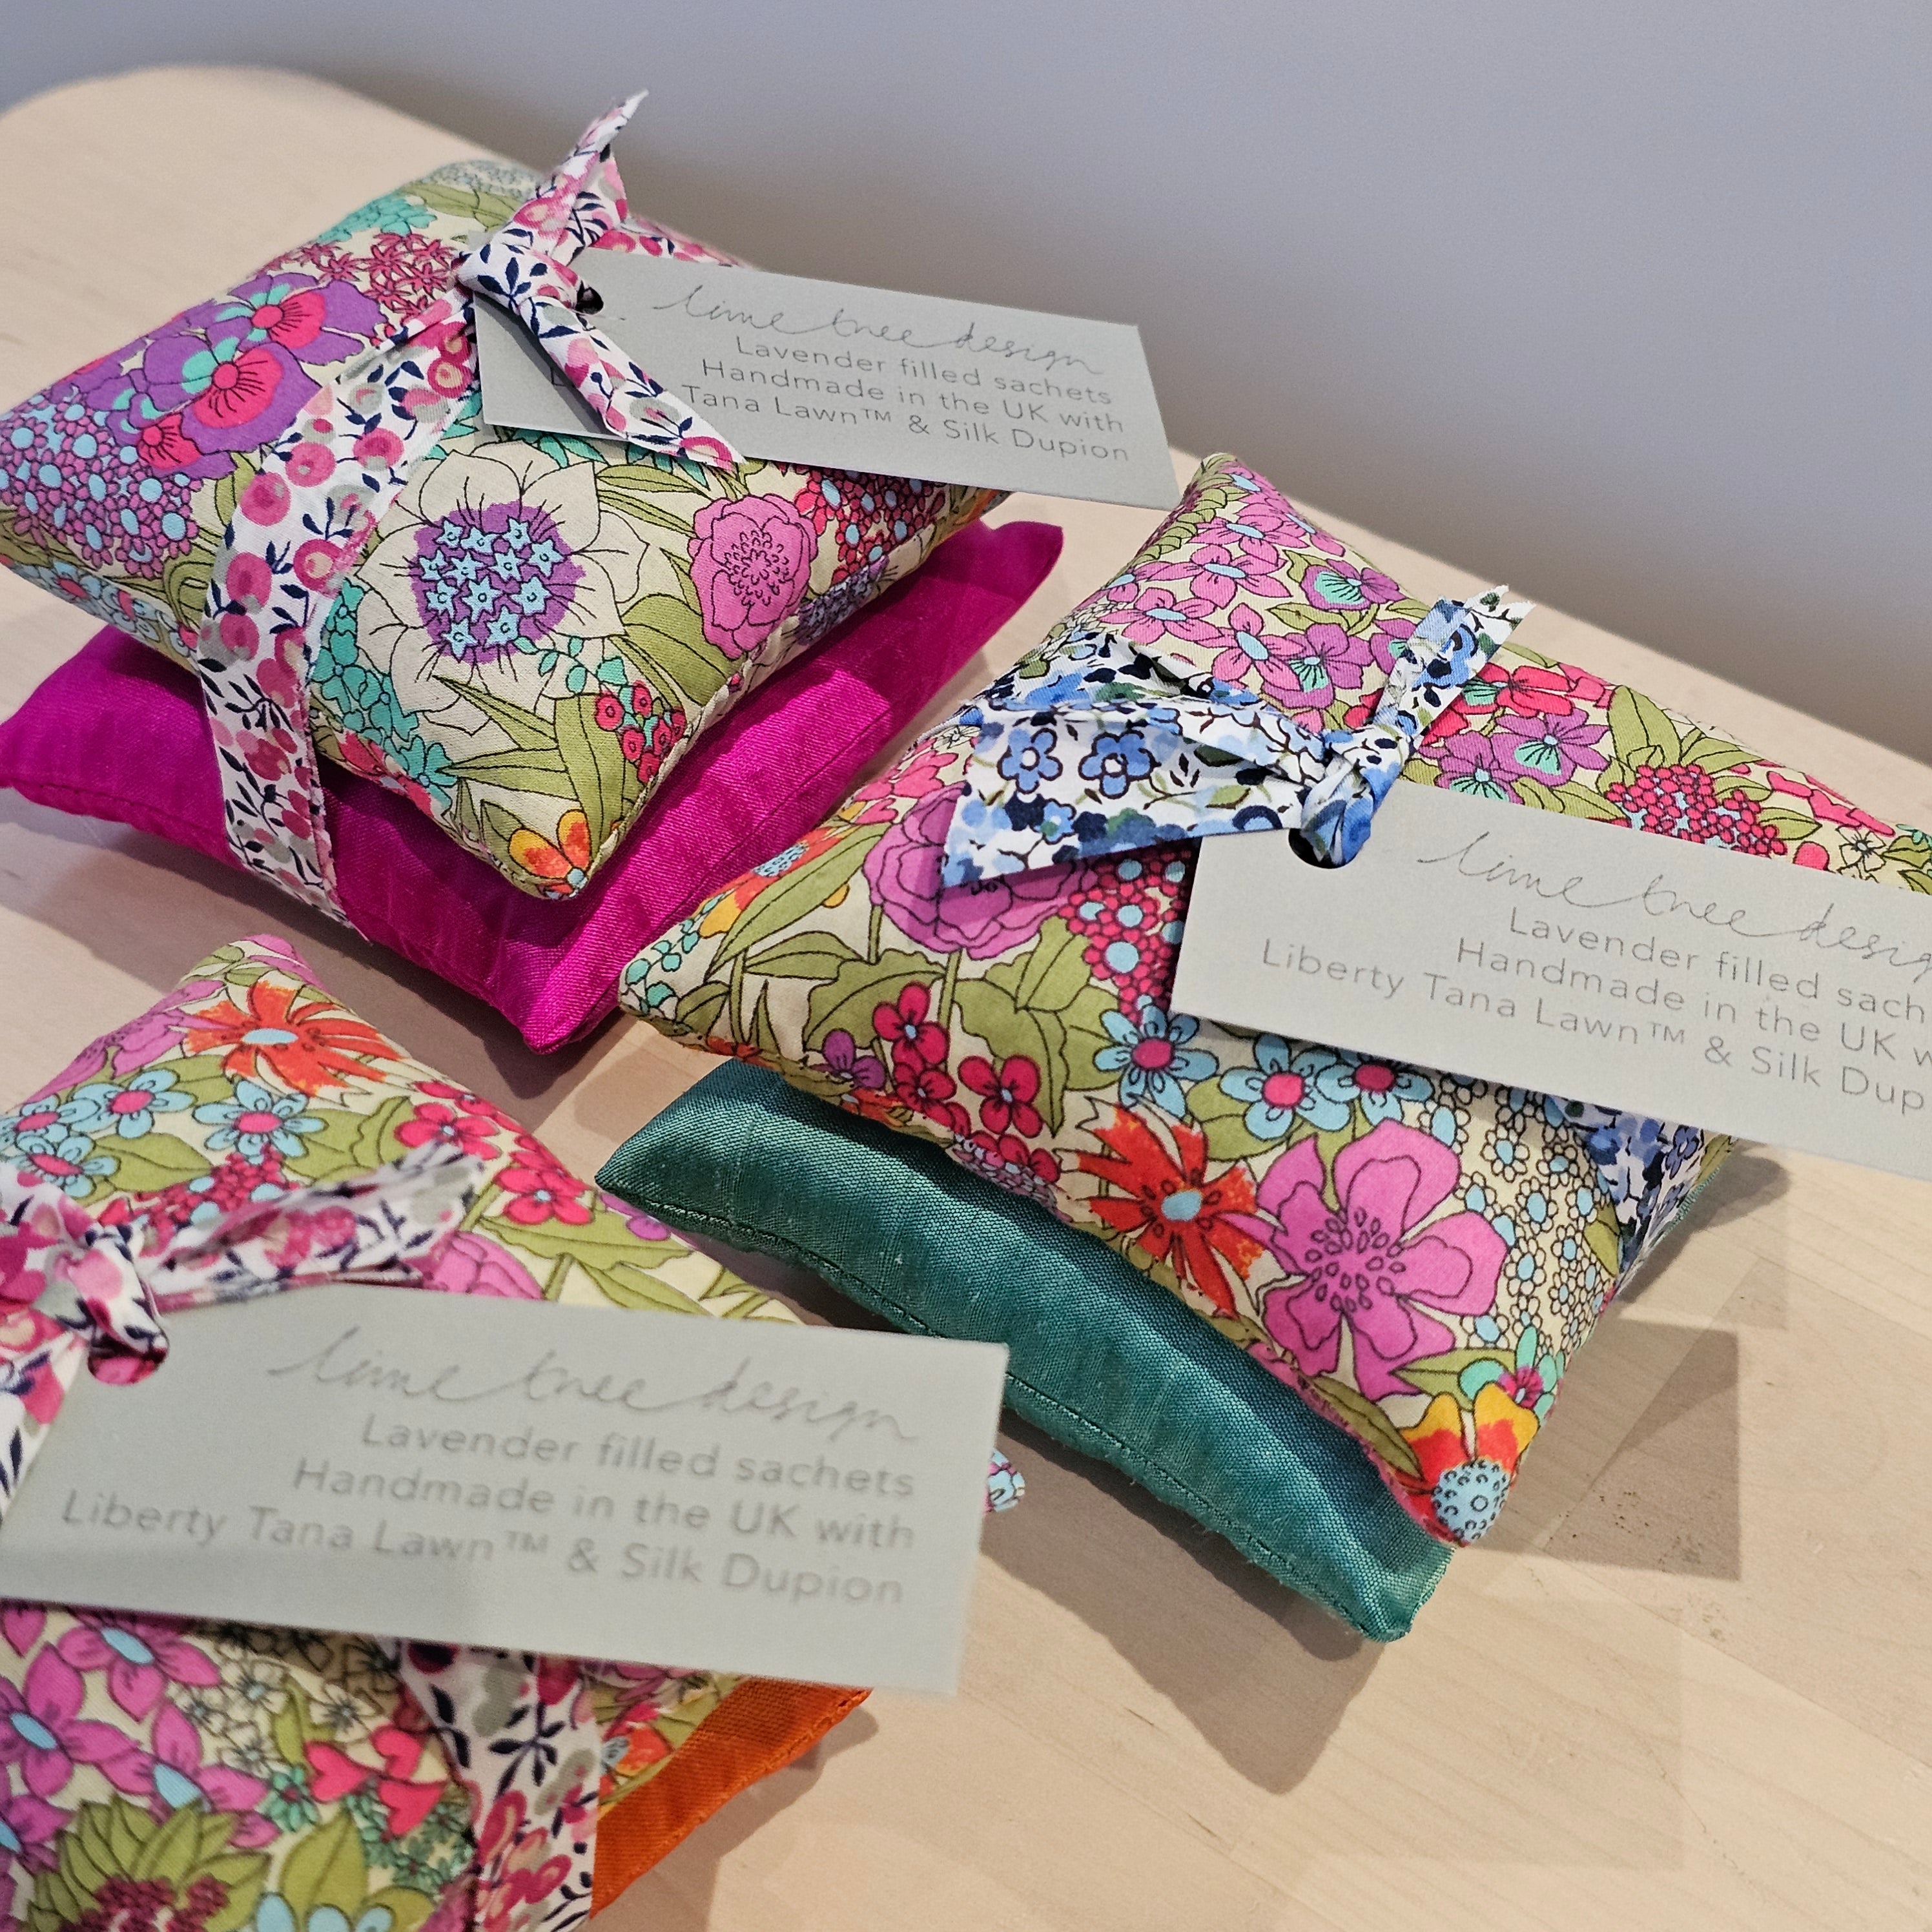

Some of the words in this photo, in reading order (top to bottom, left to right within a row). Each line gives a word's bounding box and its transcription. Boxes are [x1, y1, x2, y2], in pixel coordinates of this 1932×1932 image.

[653, 284, 802, 334] lime
[823, 308, 925, 348] tree
[952, 322, 1104, 375] design
[736, 336, 886, 372] Lavender
[900, 358, 981, 387] filled
[994, 378, 1112, 405] sachets
[682, 384, 760, 413] Tana
[909, 414, 930, 435] &
[943, 418, 1000, 444] Silk
[1011, 427, 1129, 461] Dupion
[703, 358, 884, 400] Handmade
[898, 385, 925, 407] in
[940, 391, 989, 415] the
[1003, 399, 1048, 423] UK
[1060, 412, 1124, 433] with
[1417, 831, 1595, 908] lime
[1630, 874, 1760, 938] tree
[1457, 936, 1685, 1011] Handmade
[1703, 992, 1737, 1023] in
[1755, 1005, 1821, 1042] the
[1841, 1022, 1896, 1061] UK
[1510, 907, 1700, 971] Lavender
[1715, 951, 1820, 1000] filled
[1837, 987, 1925, 1023] sach
[1263, 938, 1404, 999] Liberty
[1423, 971, 1516, 1018] Tana
[1705, 1035, 1732, 1067] &
[1751, 1045, 1822, 1087] Silk
[1842, 1065, 1924, 1116] Dup
[361, 1412, 580, 1463] Lavender
[596, 1430, 721, 1479] filled
[735, 1452, 916, 1499] sachets
[61, 1488, 227, 1547] Liberty
[248, 1503, 355, 1548] Tana
[566, 1537, 598, 1573] &
[620, 1541, 703, 1584] Silk
[721, 1550, 903, 1604] Dupion
[293, 1457, 555, 1513] Handmade
[572, 1486, 615, 1520] in
[634, 1490, 711, 1531] the
[731, 1498, 801, 1539] UK
[815, 1511, 916, 1550] with
